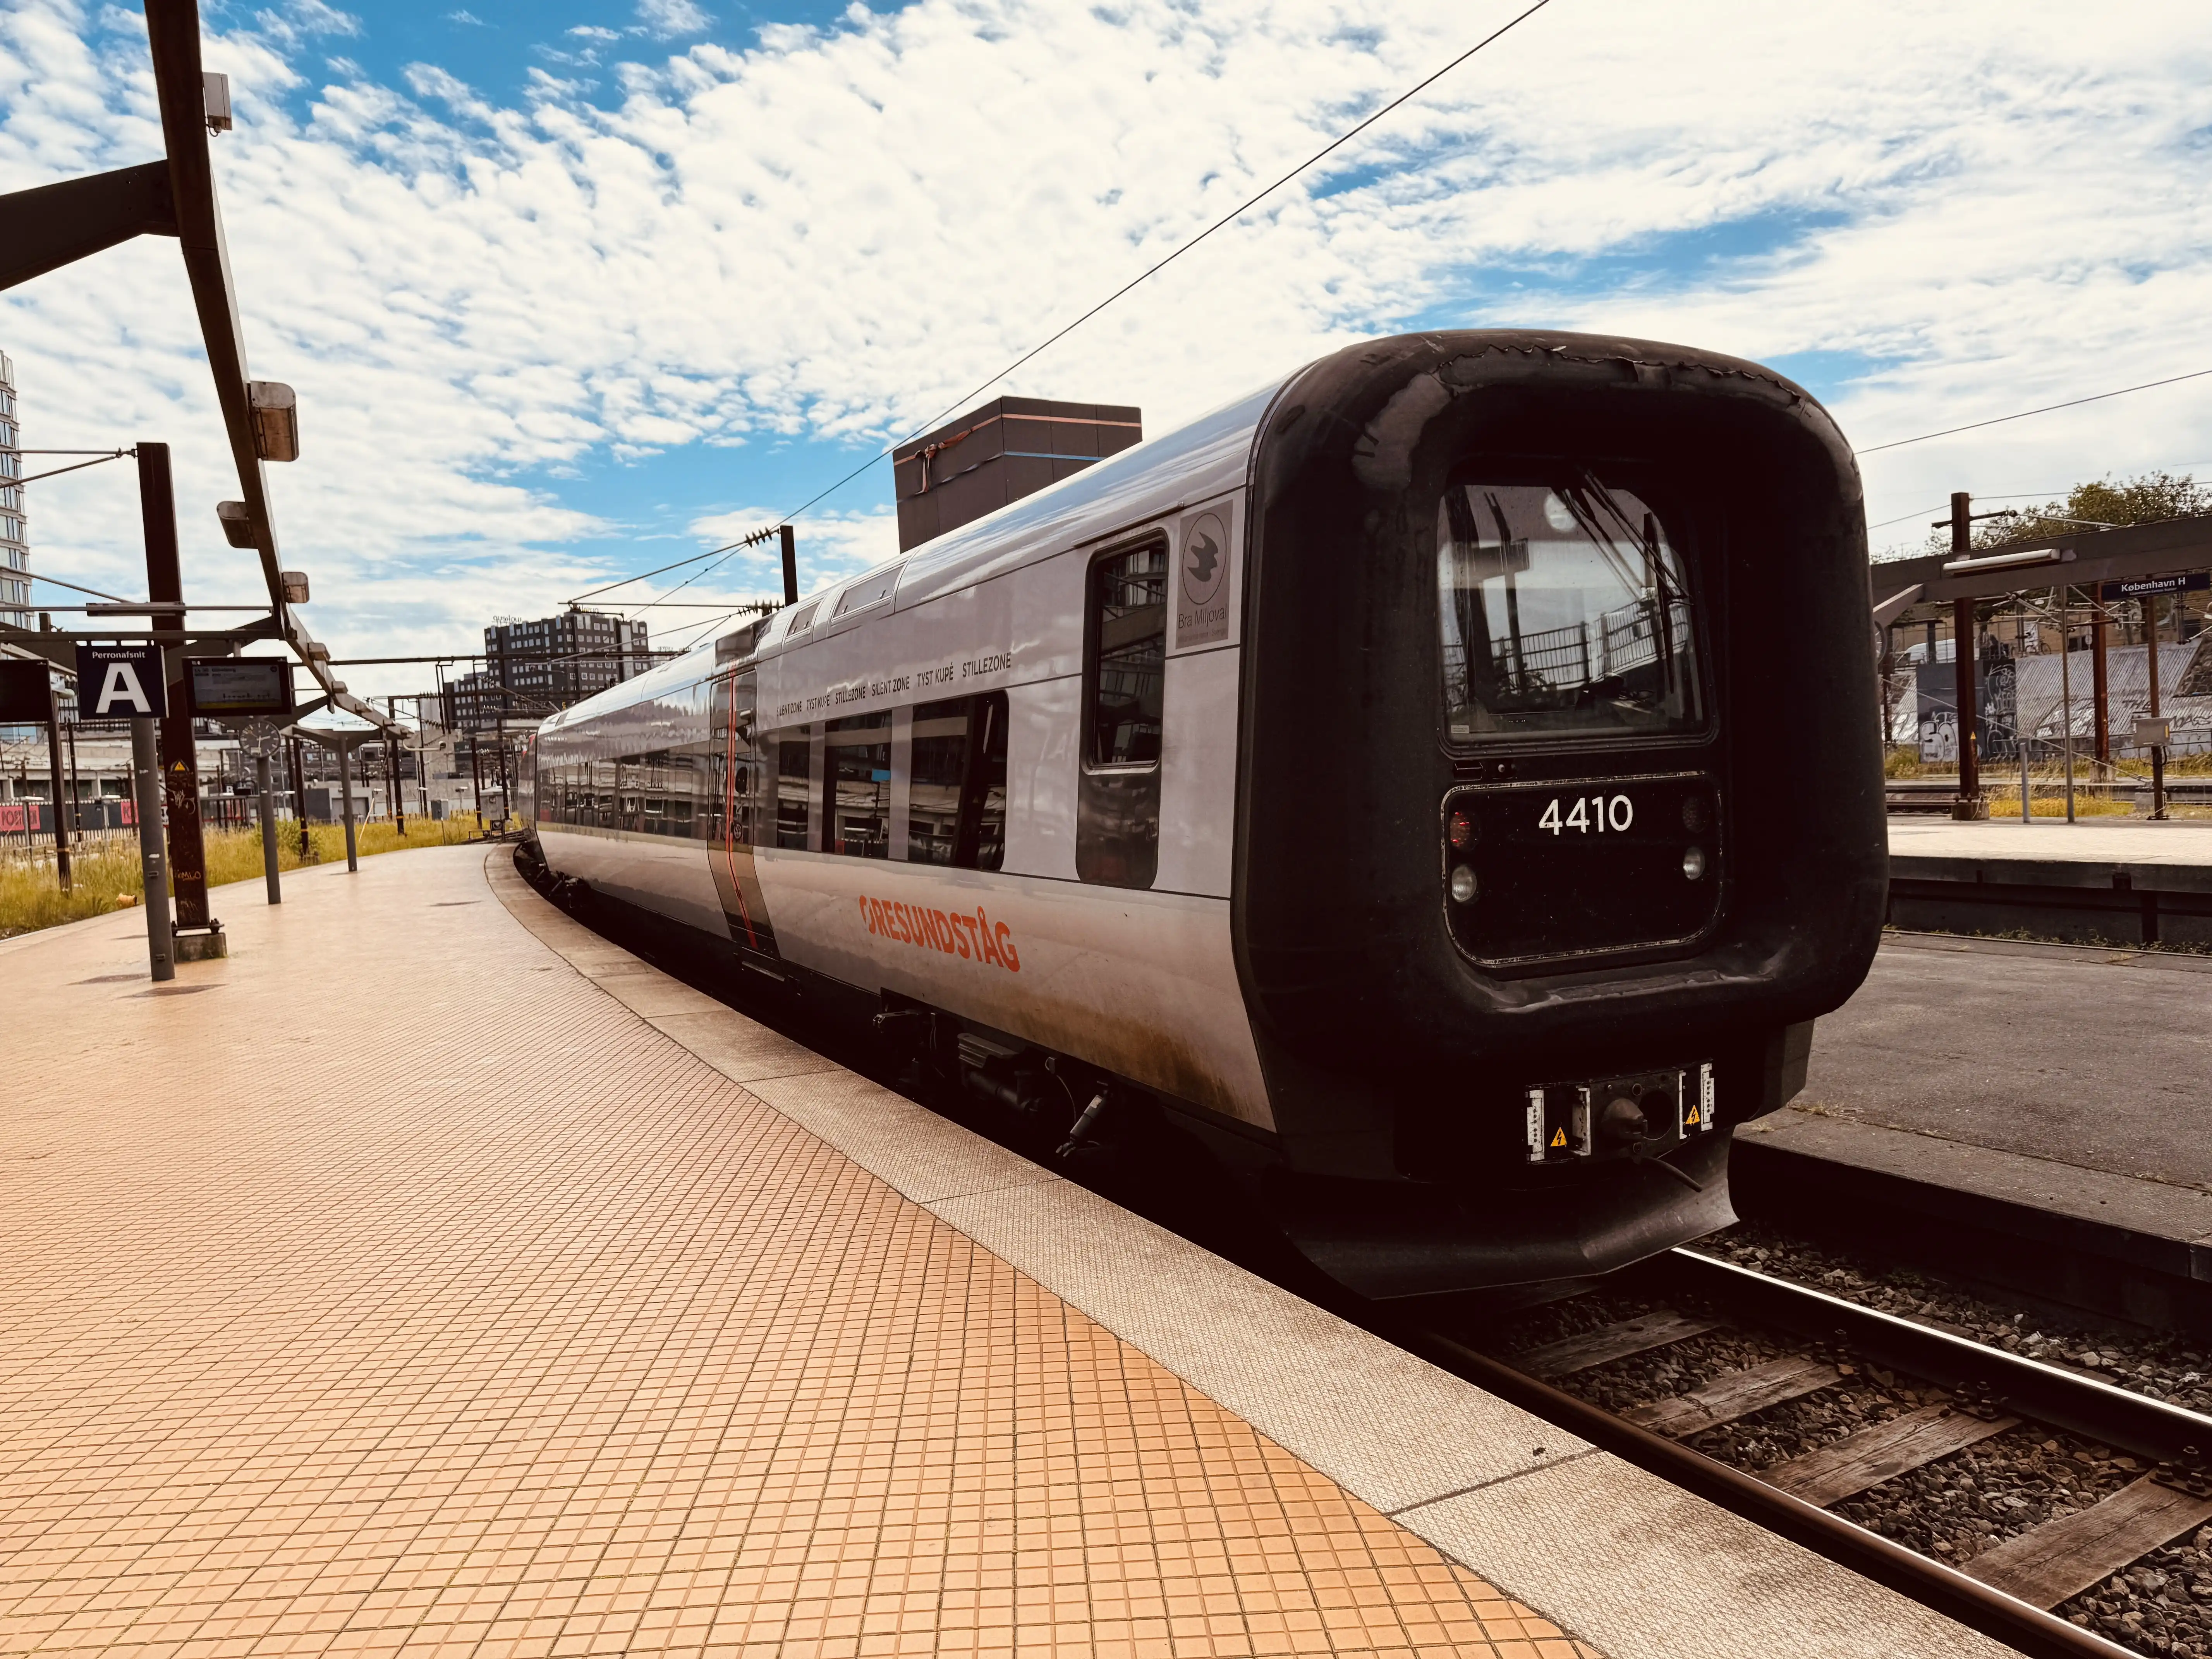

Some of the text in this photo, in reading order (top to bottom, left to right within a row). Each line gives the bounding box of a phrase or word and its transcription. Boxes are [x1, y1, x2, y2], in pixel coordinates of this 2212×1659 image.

[2121, 580, 2175, 592] København
[2178, 577, 2186, 586] H
[1178, 613, 1192, 629] Bra
[96, 662, 152, 713] A
[791, 701, 802, 714] ZONE
[807, 697, 817, 711] TYST
[835, 686, 866, 704] STILLEZONE
[872, 680, 891, 697] SILENT
[893, 676, 910, 692] ZONE
[917, 670, 933, 687] TYST
[935, 661, 953, 684] KUPÉ
[963, 652, 1012, 678] STILLEZONE
[1538, 795, 1633, 835] 4410
